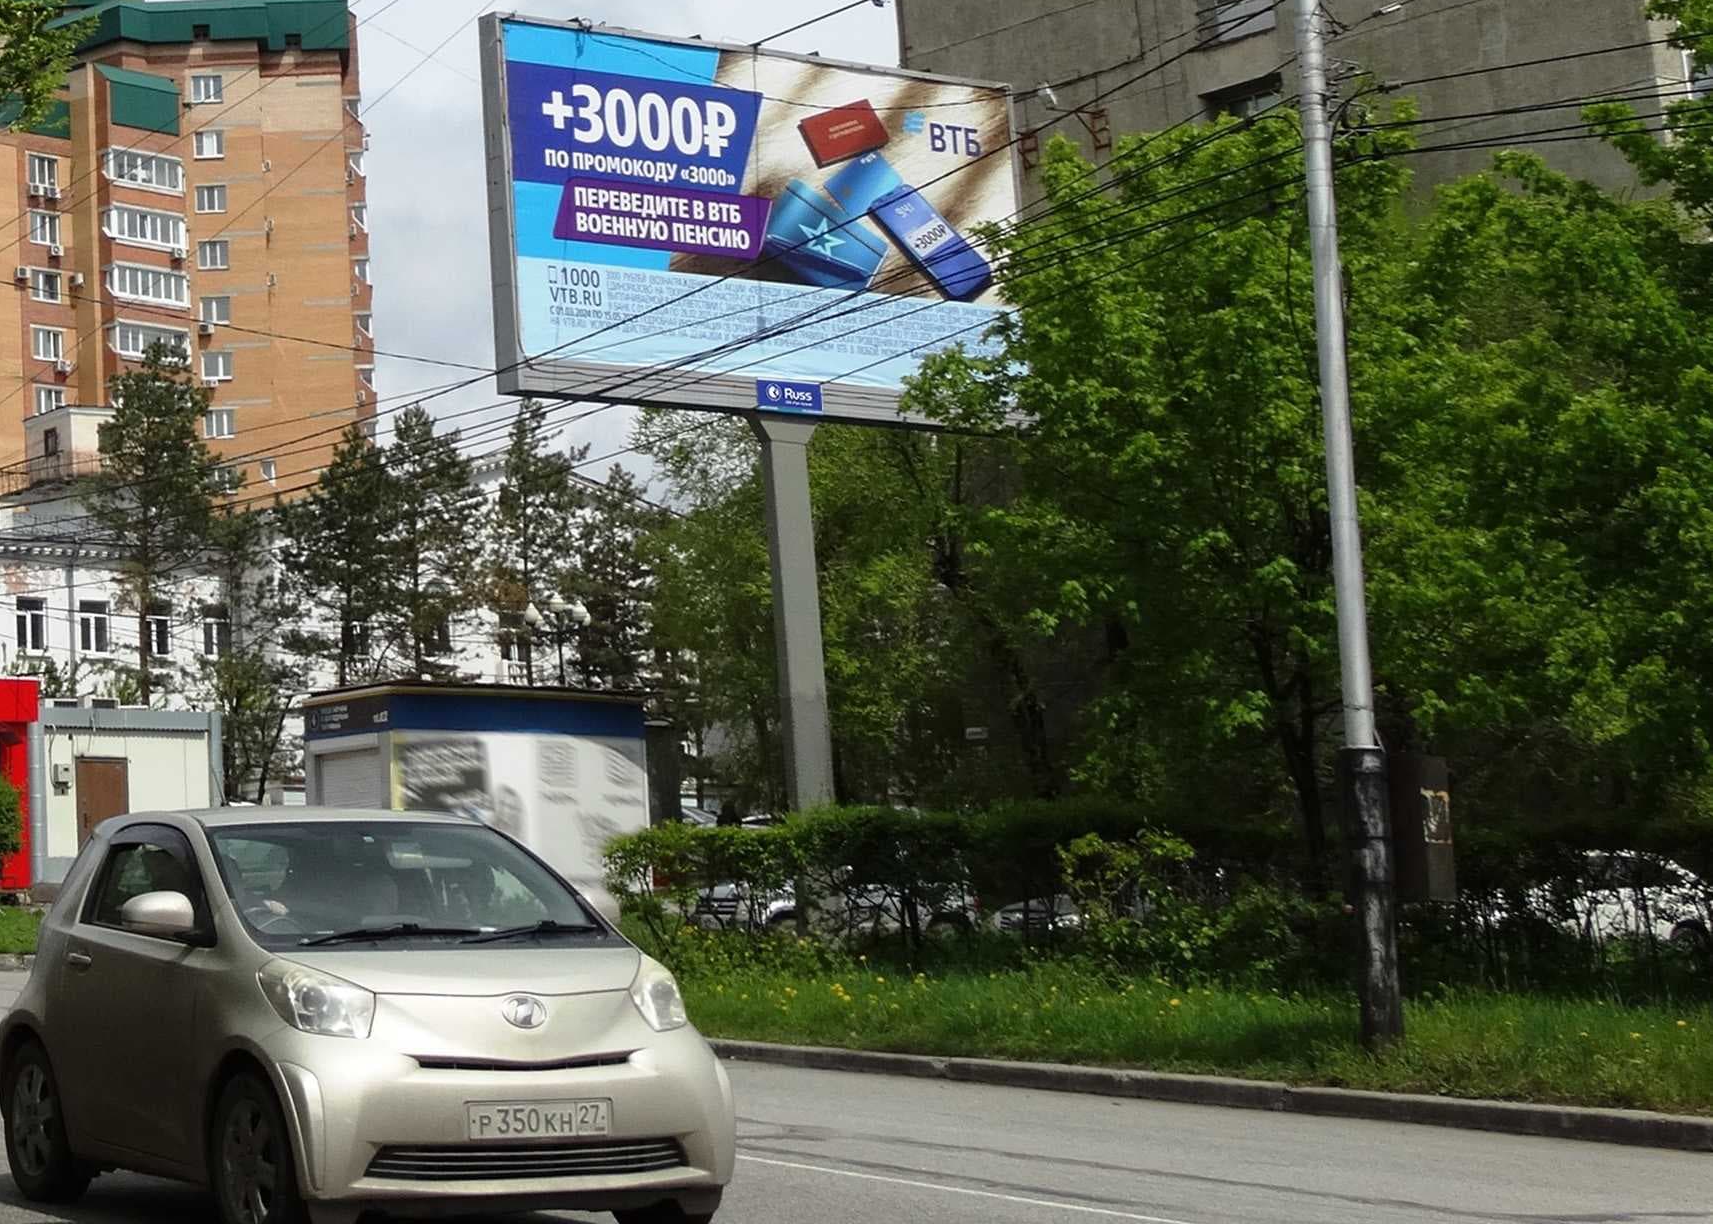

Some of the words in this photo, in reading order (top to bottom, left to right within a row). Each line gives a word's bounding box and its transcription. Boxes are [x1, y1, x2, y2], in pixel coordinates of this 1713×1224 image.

[929, 122, 982, 158] ВТБ
[544, 148, 569, 168] ПО
[572, 152, 678, 183] ПРОМОКОДУ
[574, 186, 690, 219] ПЕРЕВЕДИТЕ
[693, 201, 704, 220] В
[709, 202, 741, 224] ВТБ
[575, 212, 669, 241] ВОЕННУЮ
[672, 224, 750, 250] ПЕНСИЮ
[561, 268, 600, 288] 1000
[550, 287, 602, 307] VTB.RU
[784, 387, 813, 401] Russ
[579, 1105, 600, 1124] 27
